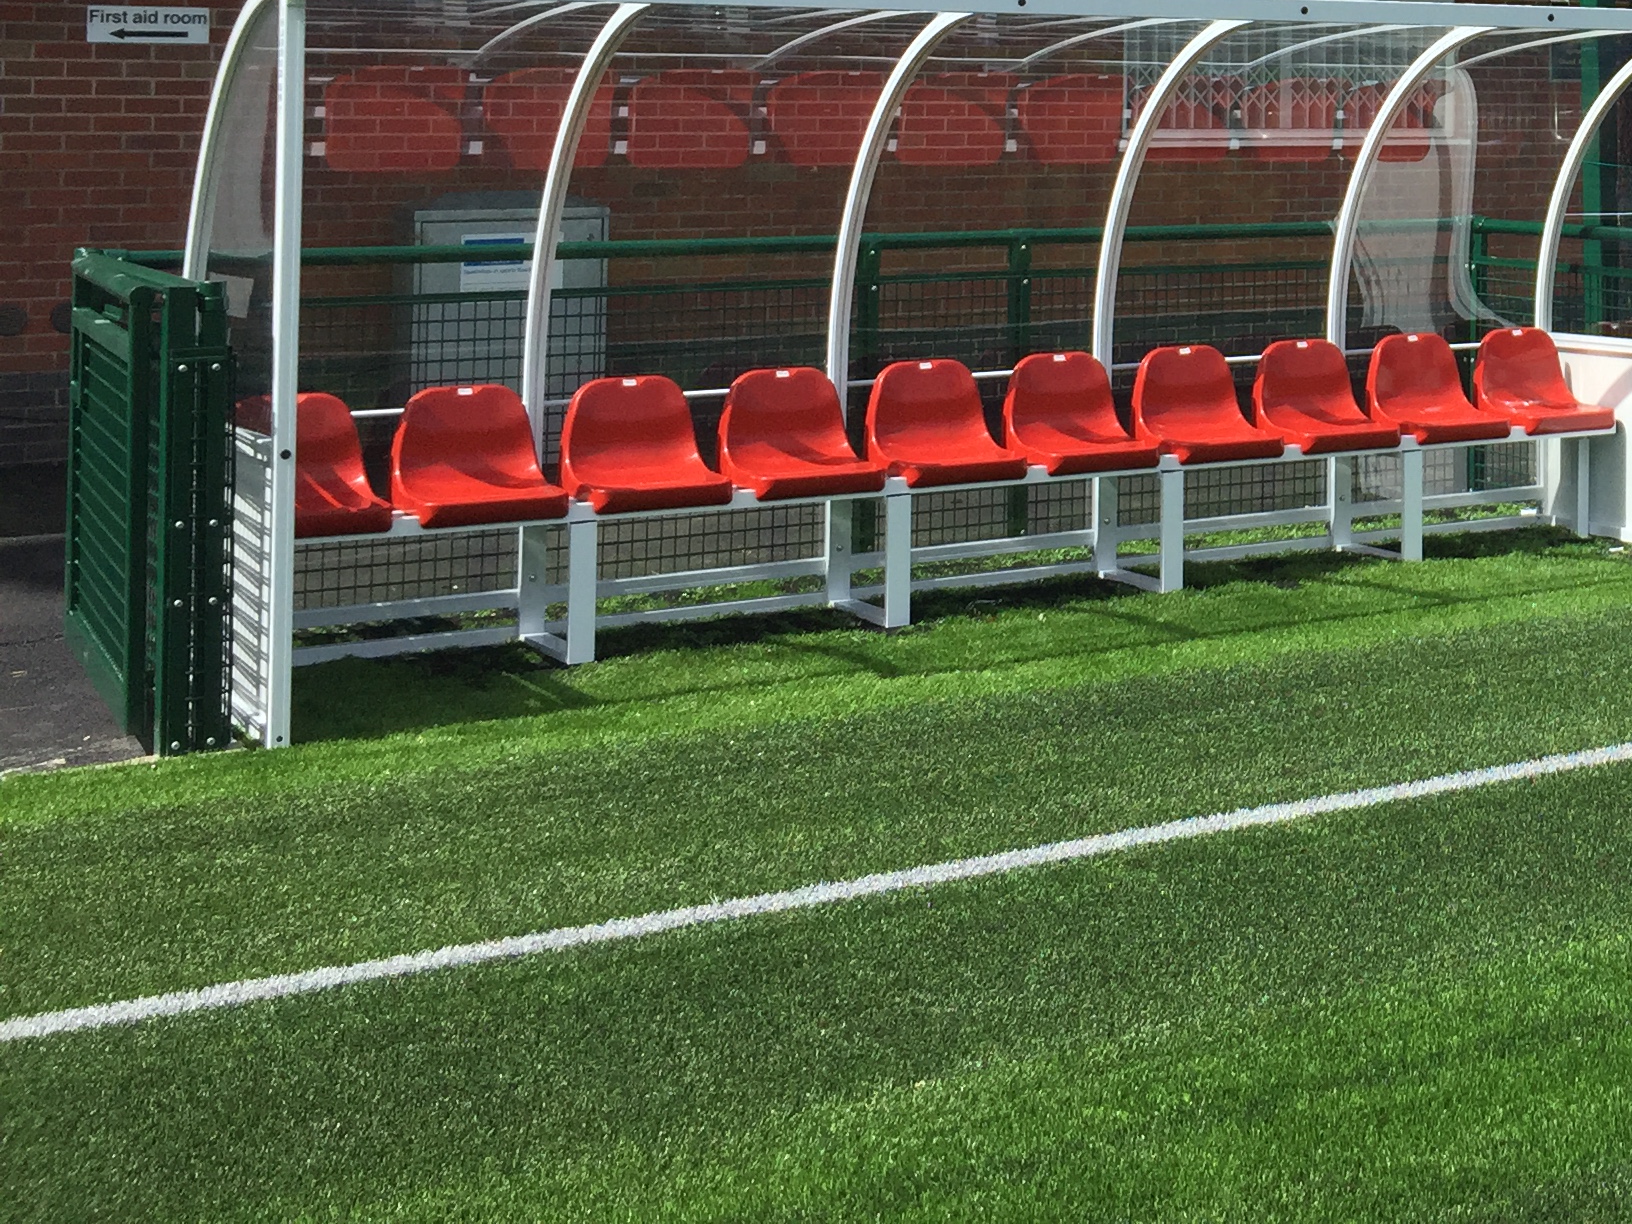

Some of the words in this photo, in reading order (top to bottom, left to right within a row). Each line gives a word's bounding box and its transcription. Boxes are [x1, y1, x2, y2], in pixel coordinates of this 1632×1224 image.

[89, 9, 128, 24] First
[132, 10, 158, 25] aid
[163, 12, 208, 25] room
